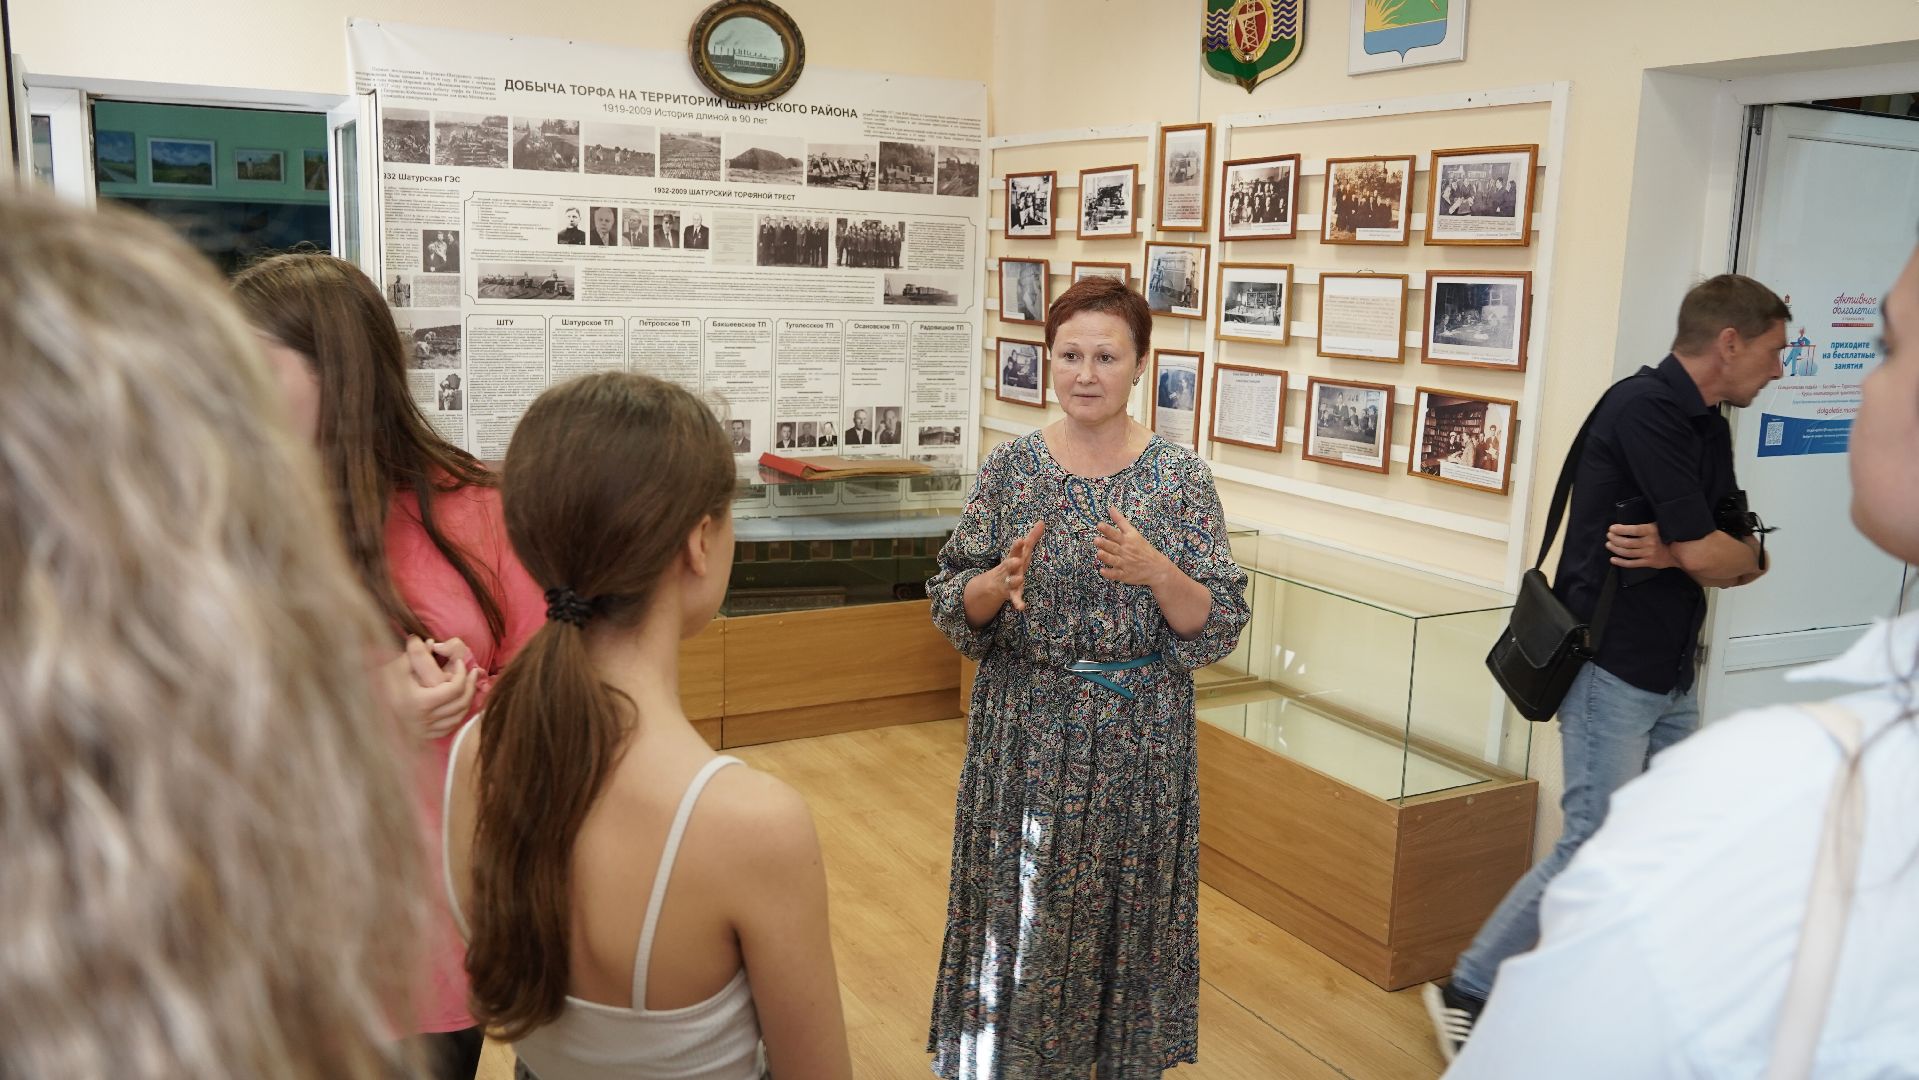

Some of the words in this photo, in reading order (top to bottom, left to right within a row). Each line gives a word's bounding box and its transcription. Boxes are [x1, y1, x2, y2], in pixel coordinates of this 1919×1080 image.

[504, 79, 566, 94] ДОБЫЧА
[569, 84, 615, 98] ТОРФА
[619, 89, 637, 100] НА
[640, 91, 722, 109] ТЕРРИТОРИИ
[726, 101, 807, 114] ШАТУРСКОГО
[811, 104, 858, 118] РАЙОНА
[603, 104, 652, 116] 1919-2009
[655, 108, 693, 119] История
[696, 112, 729, 121] длиной
[398, 173, 442, 183] Шатурская
[444, 175, 461, 183] ГЭС
[654, 187, 688, 195] 1932-2009
[689, 189, 732, 198] ШАТУРСКИЙ
[733, 191, 772, 200] ТОРФЯНОЙ
[774, 193, 795, 201] ТРЕСТ
[1834, 292, 1877, 305] Активное
[1832, 306, 1876, 315] долголетие
[561, 319, 602, 328] Шатурское
[639, 320, 680, 328] Петровское
[785, 322, 824, 330] Туголесское
[919, 324, 954, 332] Радовицкое
[1831, 341, 1871, 350] приходите
[1832, 350, 1876, 359] бесплатные
